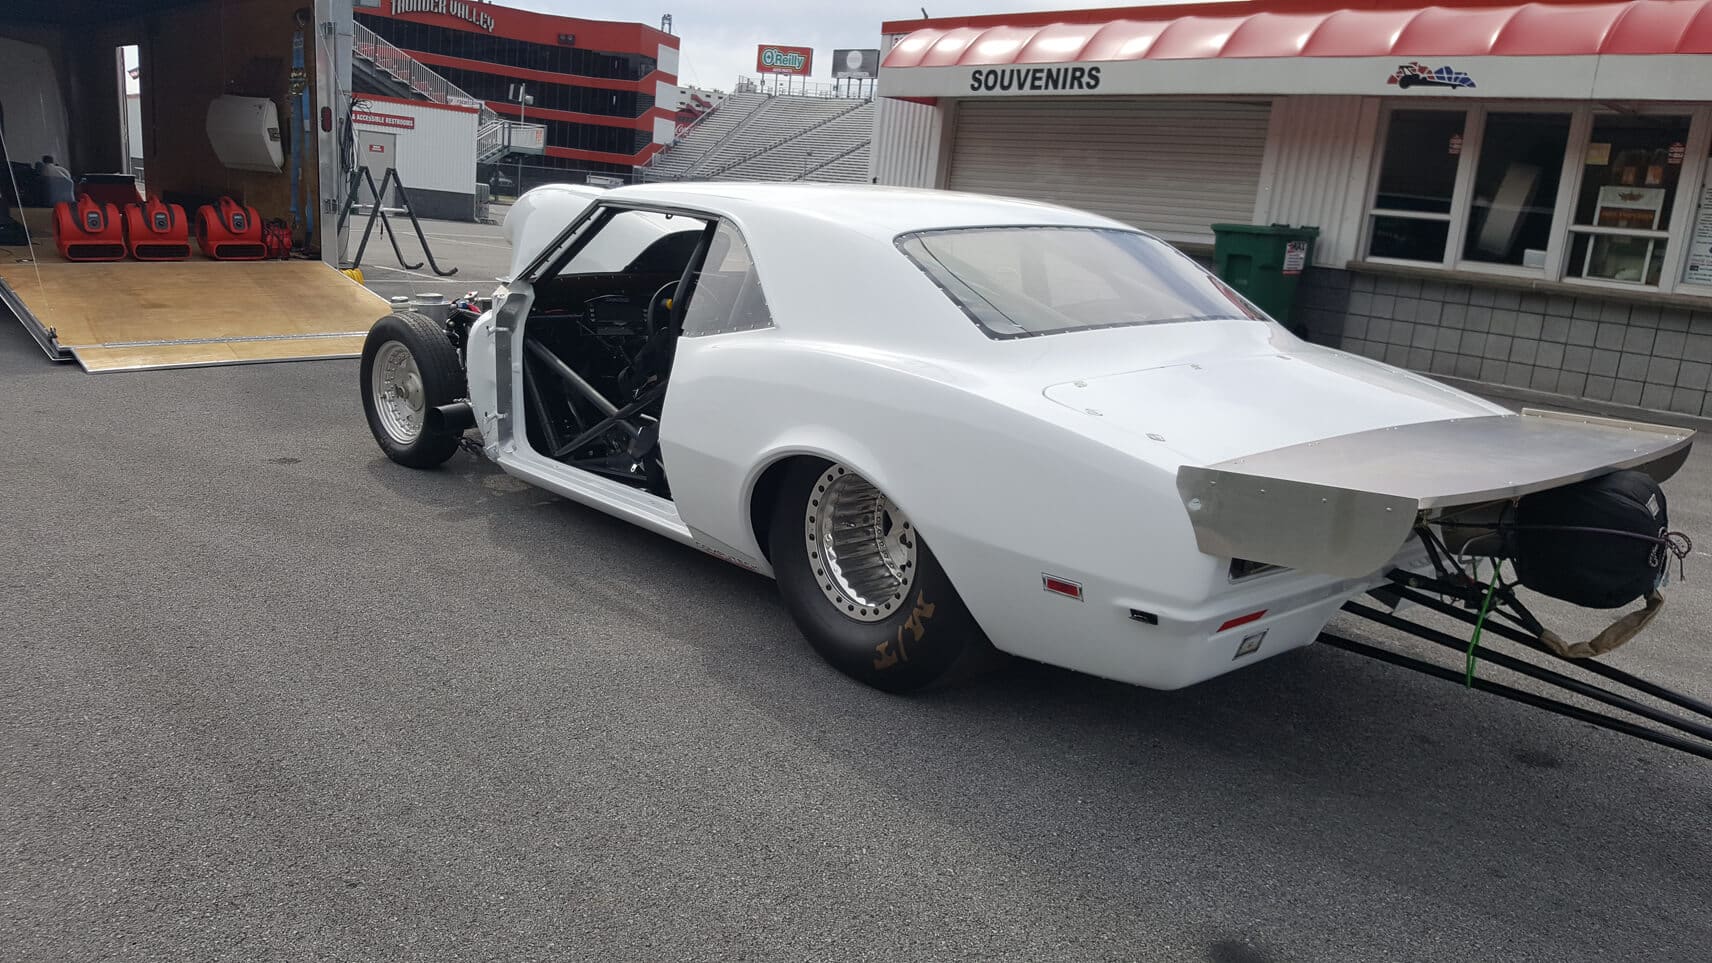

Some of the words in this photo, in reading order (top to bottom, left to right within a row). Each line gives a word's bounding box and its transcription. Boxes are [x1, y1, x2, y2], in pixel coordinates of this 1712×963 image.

[391, 0, 446, 15] THUNDER
[449, 0, 495, 32] VALLEY
[762, 48, 805, 69] O'Reilly
[970, 66, 1102, 91] SOUVENIRS
[357, 114, 384, 123] ACCESSIBLE
[385, 117, 413, 127] RESTROOMS
